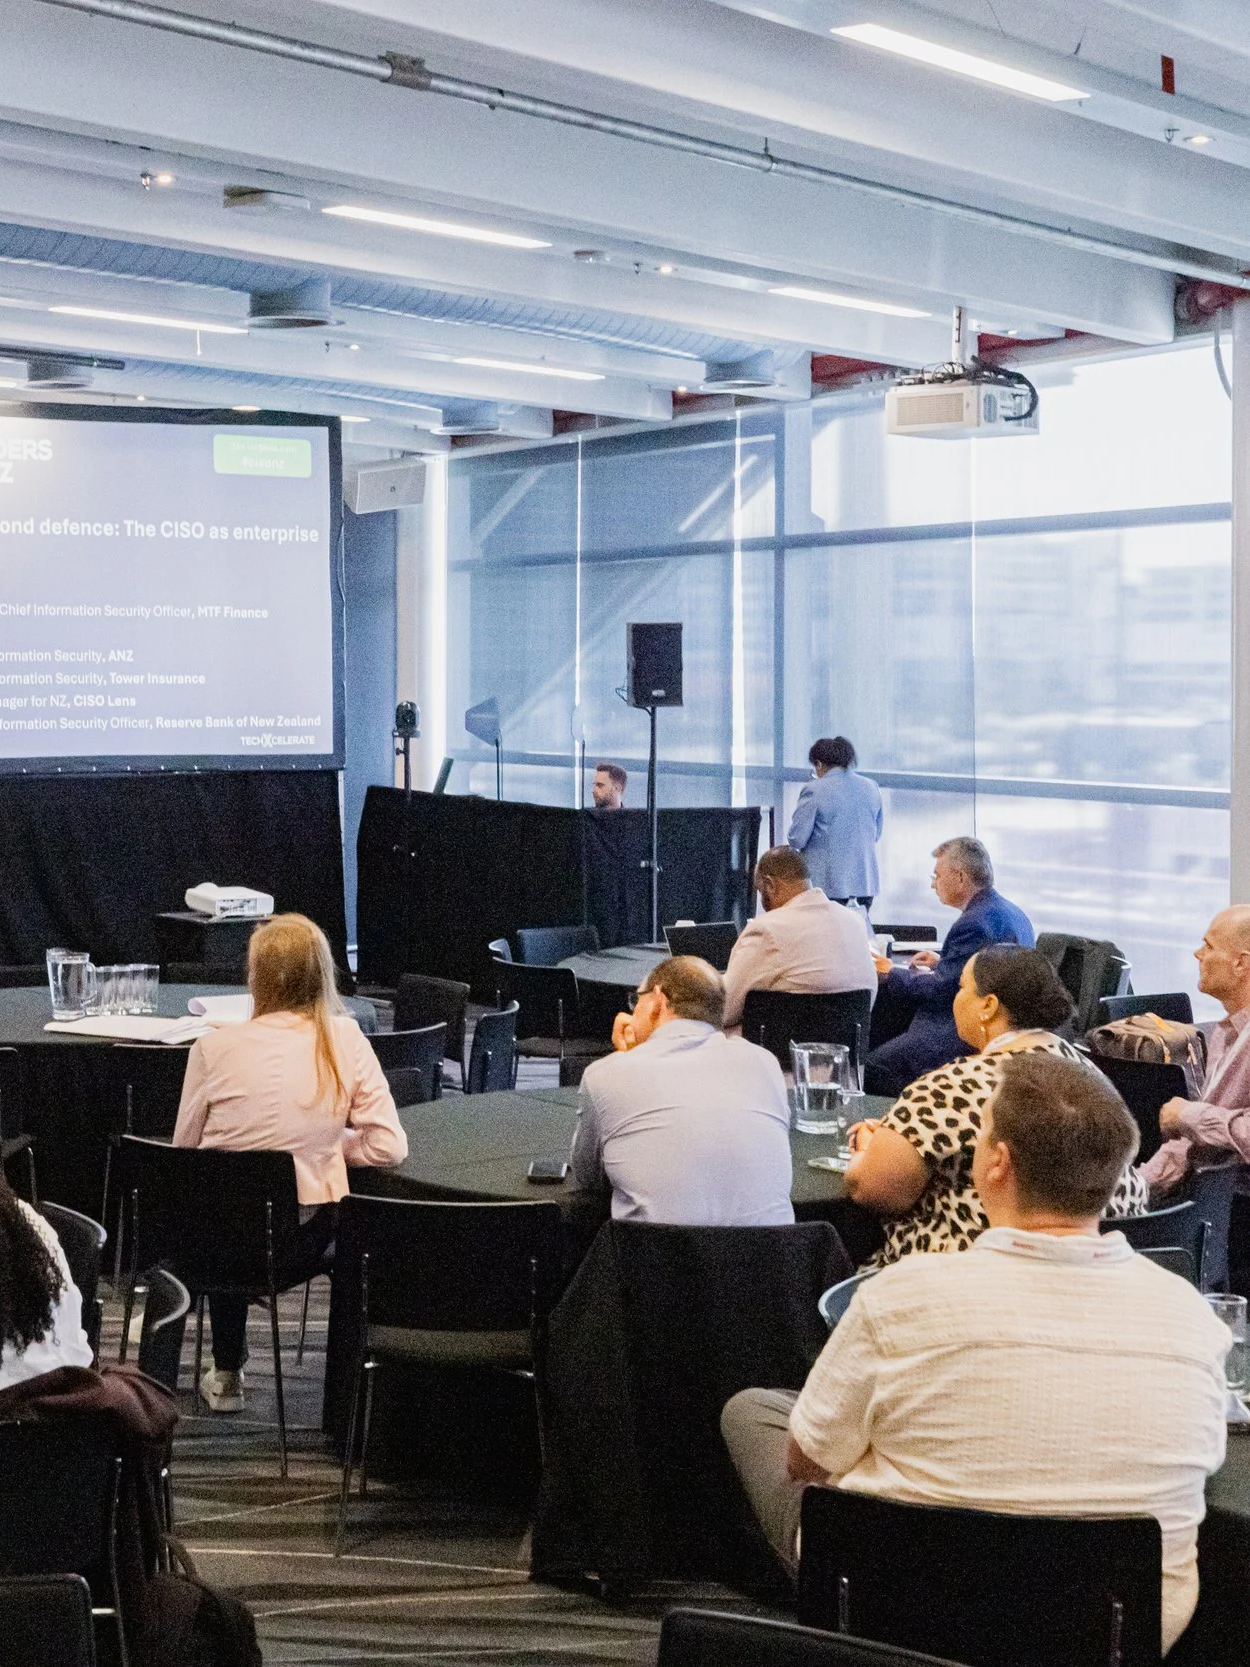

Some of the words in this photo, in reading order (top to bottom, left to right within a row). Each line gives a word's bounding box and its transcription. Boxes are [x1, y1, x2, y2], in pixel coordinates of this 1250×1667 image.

[39, 518, 120, 537] defence:
[123, 520, 156, 538] The
[160, 520, 205, 539] CISO
[209, 527, 229, 540] as
[233, 525, 319, 545] enterprise
[33, 603, 102, 617] Information
[104, 604, 150, 620] Security
[153, 605, 195, 620] Officer,
[198, 606, 221, 618] MTF
[224, 606, 269, 619] Finance
[54, 650, 106, 665] Security,
[108, 650, 134, 662] ANZ
[55, 672, 107, 687] Security,
[110, 672, 145, 685] Tower
[147, 672, 206, 685] Insurance
[31, 695, 48, 708] for
[50, 695, 71, 709] NZ,
[73, 694, 105, 707] CISO
[107, 694, 137, 707] Lens
[59, 717, 108, 732] Security
[110, 716, 153, 731] Officer,
[156, 716, 203, 729] Reserve
[205, 716, 234, 728] Bank
[236, 715, 248, 728] of
[250, 715, 274, 727] New
[277, 714, 322, 727] Zealand
